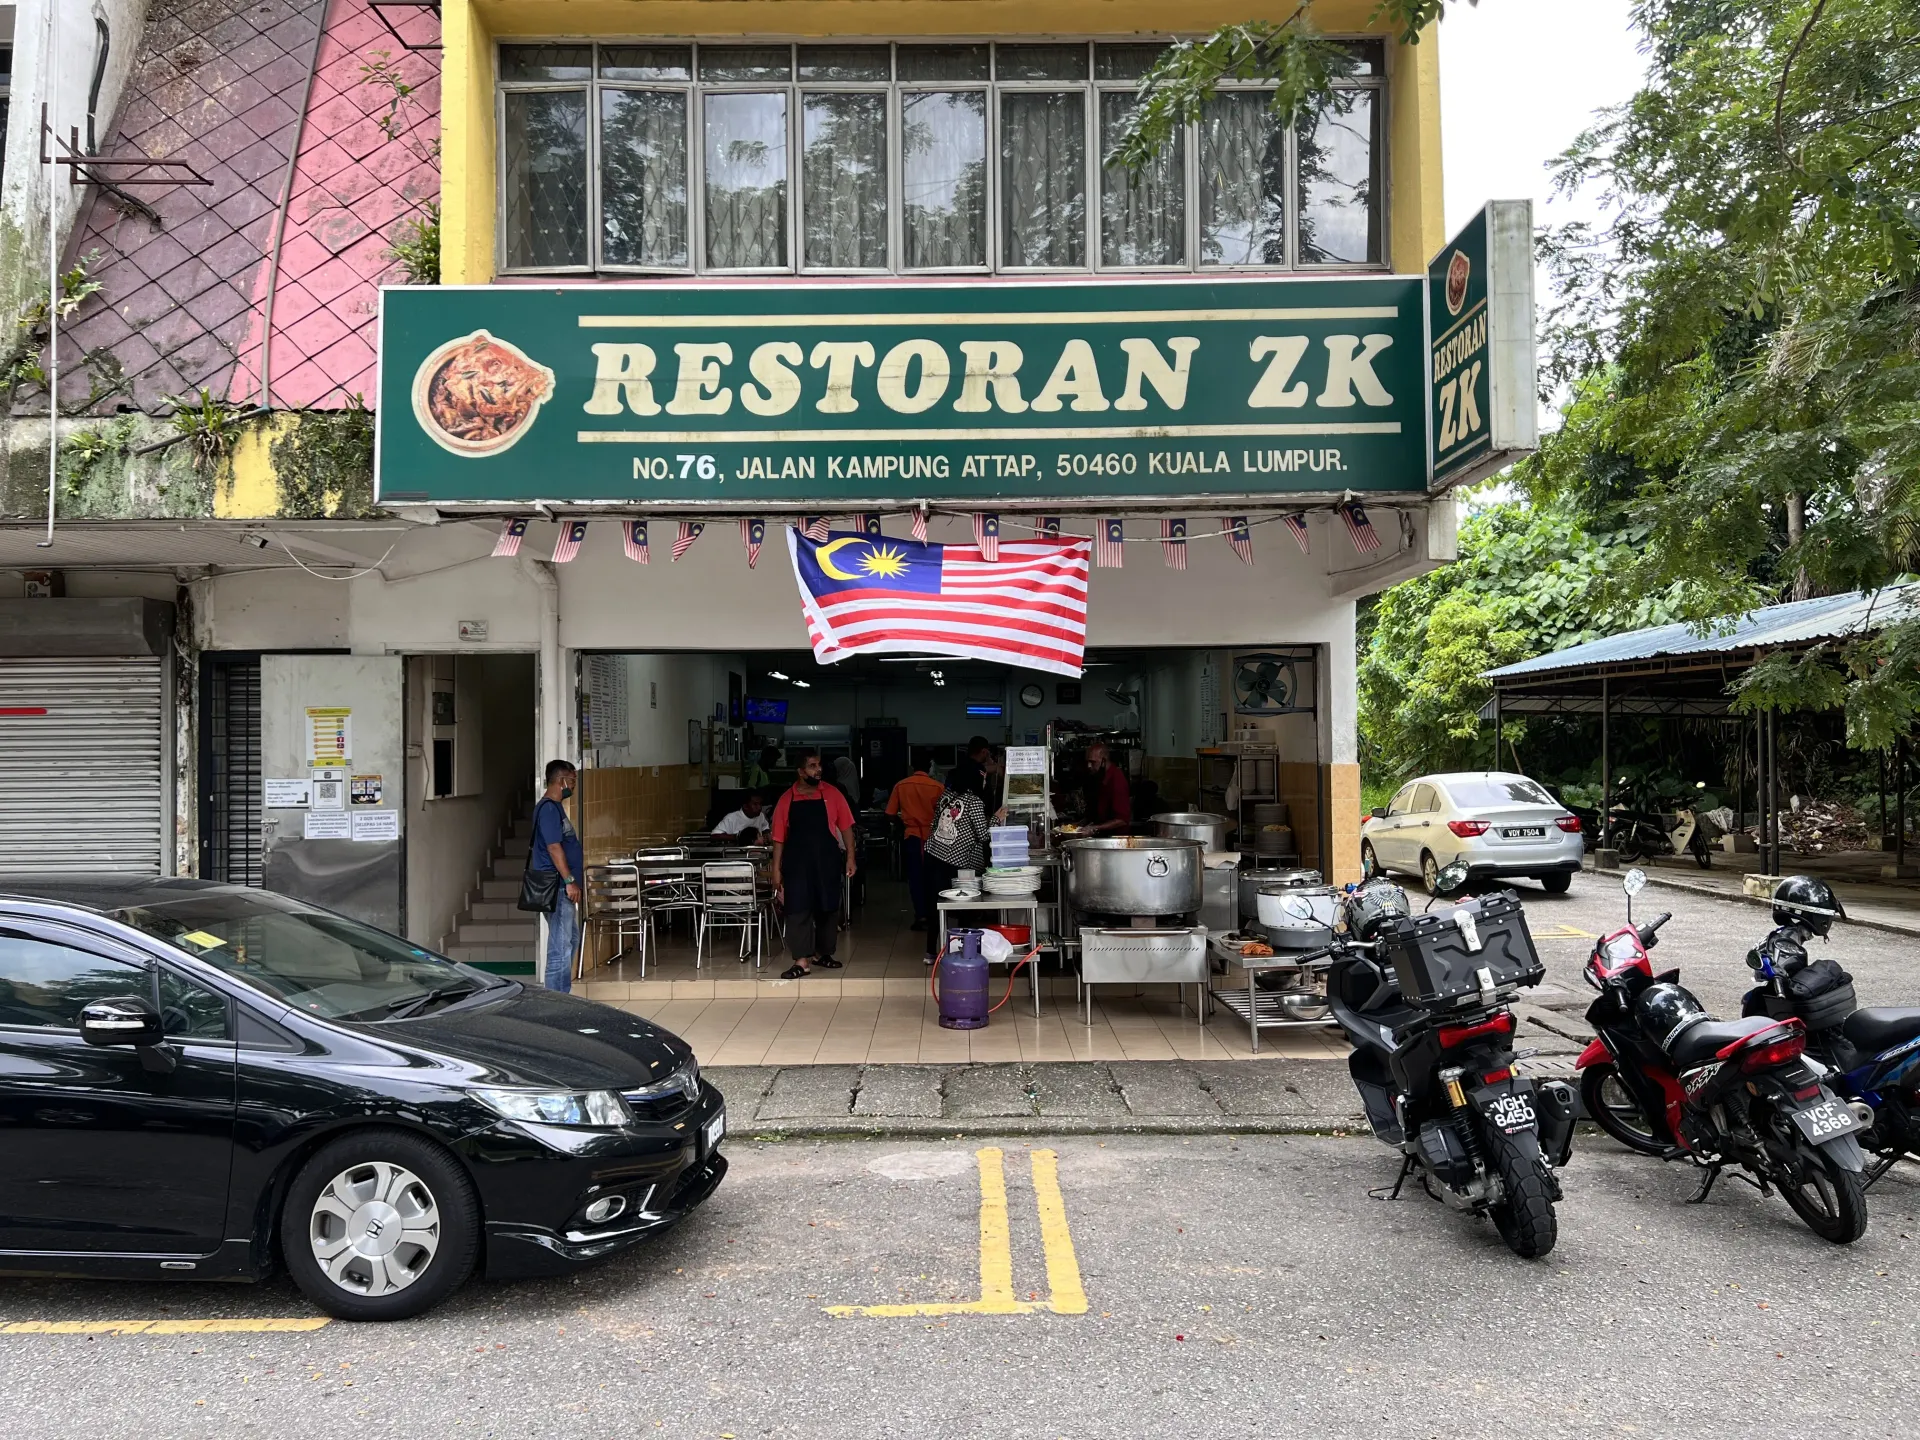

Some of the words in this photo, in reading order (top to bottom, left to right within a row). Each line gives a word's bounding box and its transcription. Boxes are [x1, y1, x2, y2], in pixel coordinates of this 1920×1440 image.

[1433, 309, 1487, 383] RESTORAN
[583, 337, 1200, 416] RESTORAN
[1247, 333, 1395, 408] ZK
[1438, 359, 1482, 452] ZK
[736, 456, 816, 479] JALAN
[827, 454, 950, 479] KAMPUNG
[962, 454, 1043, 481] ATTAP,
[1056, 453, 1138, 476] 50460
[1149, 451, 1232, 475] KUALA
[1243, 449, 1349, 474] LUMPUR.
[1508, 828, 1521, 837] VDY
[1522, 828, 1540, 836] 7504
[1493, 1094, 1526, 1114] VGH
[1804, 1102, 1834, 1123] VCF
[1494, 1106, 1536, 1128] 8450
[1812, 1113, 1852, 1137] 4368
